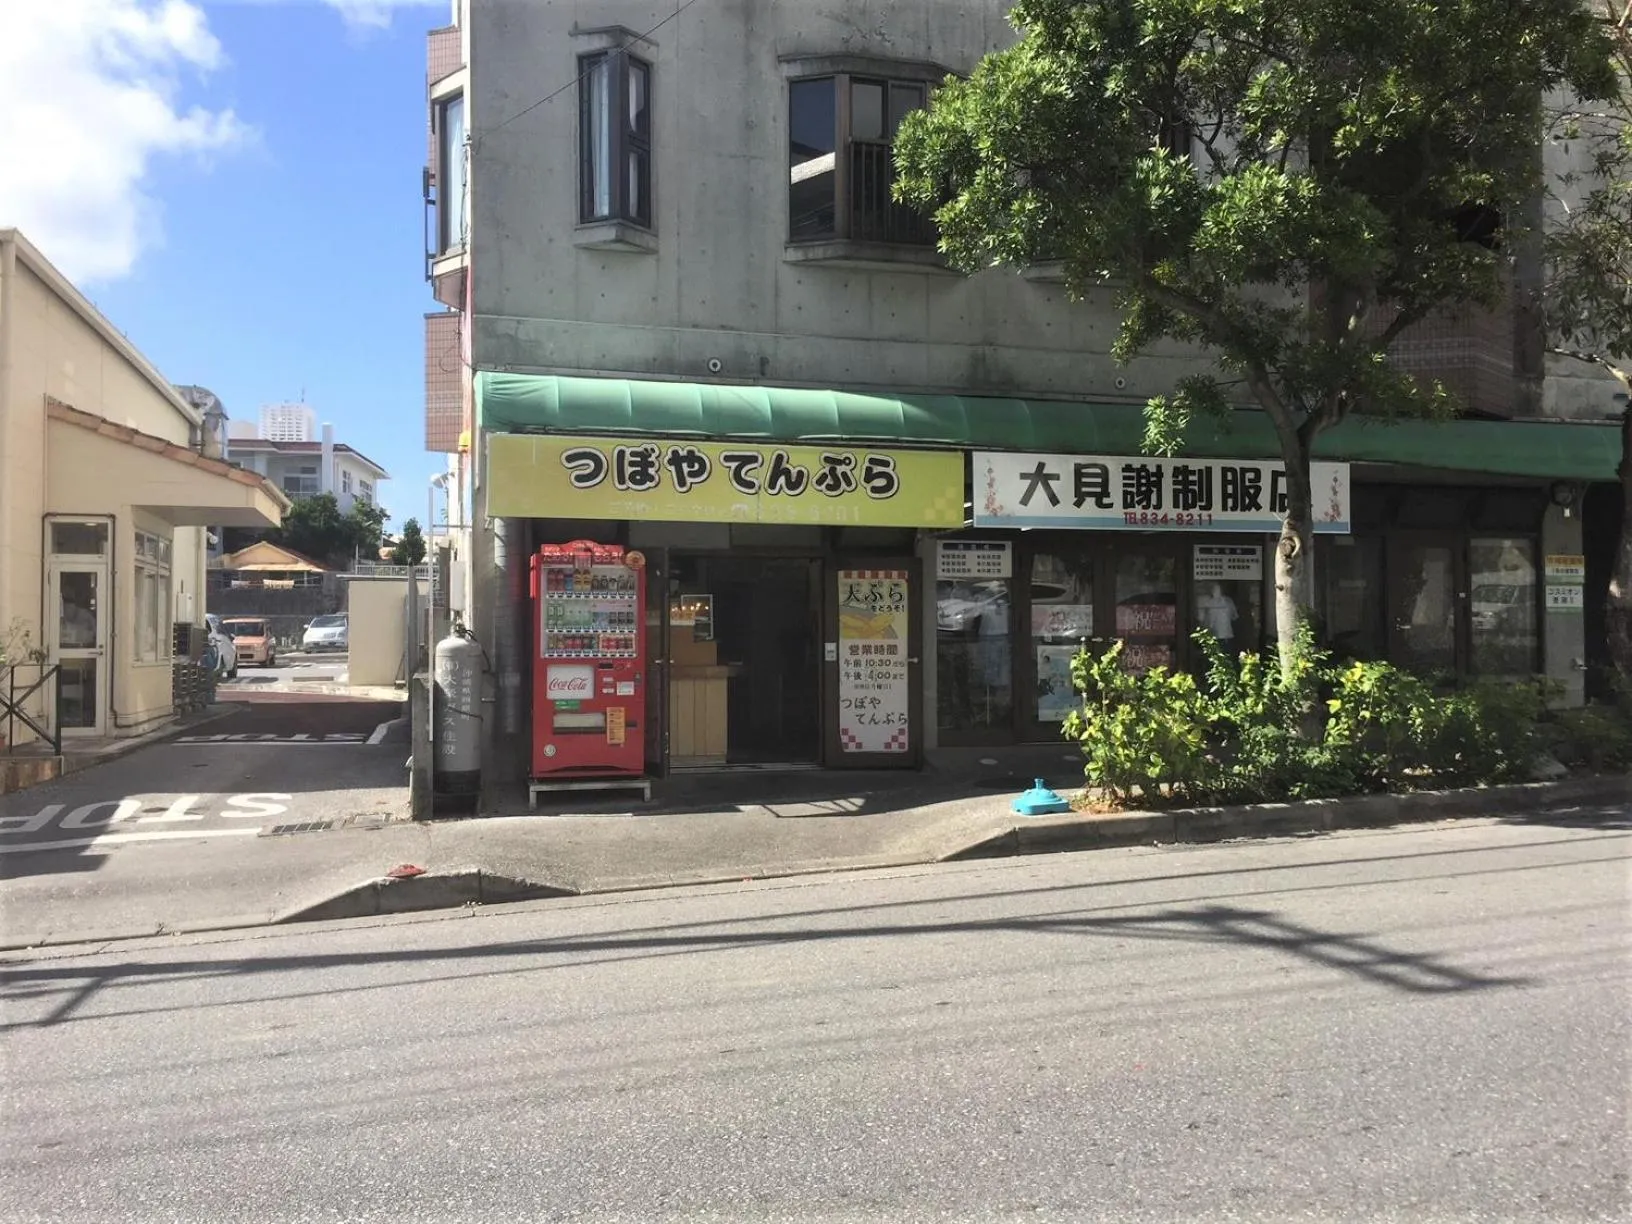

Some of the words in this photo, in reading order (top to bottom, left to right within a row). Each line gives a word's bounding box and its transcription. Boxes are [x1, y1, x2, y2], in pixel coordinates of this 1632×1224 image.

[561, 443, 899, 498] つぼやてんぷら
[849, 644, 898, 656] 営業時間
[549, 677, 589, 691] Coca-Cola
[840, 695, 881, 709] つぼや
